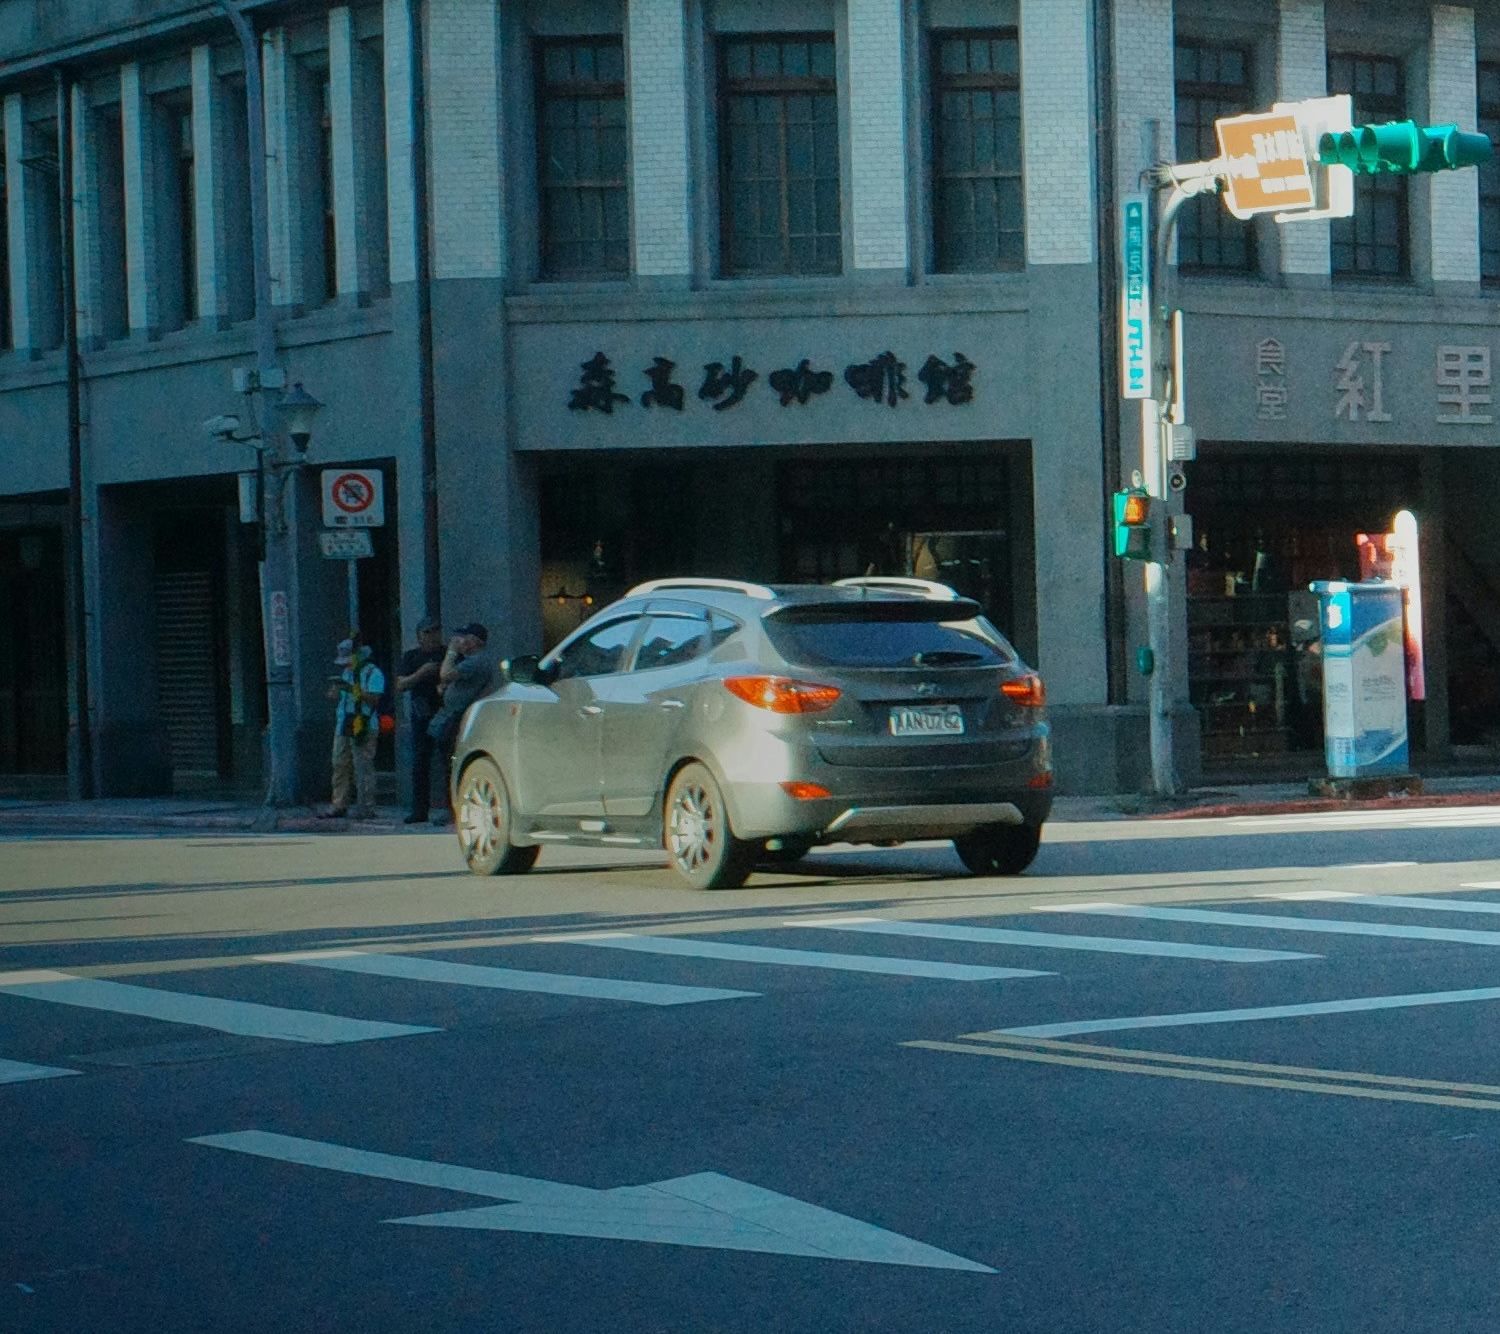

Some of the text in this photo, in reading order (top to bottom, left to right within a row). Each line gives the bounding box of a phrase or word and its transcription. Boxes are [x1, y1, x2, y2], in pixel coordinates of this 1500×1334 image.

[568, 350, 976, 414] 森高砂咖啡館
[1256, 337, 1288, 422] 食堂
